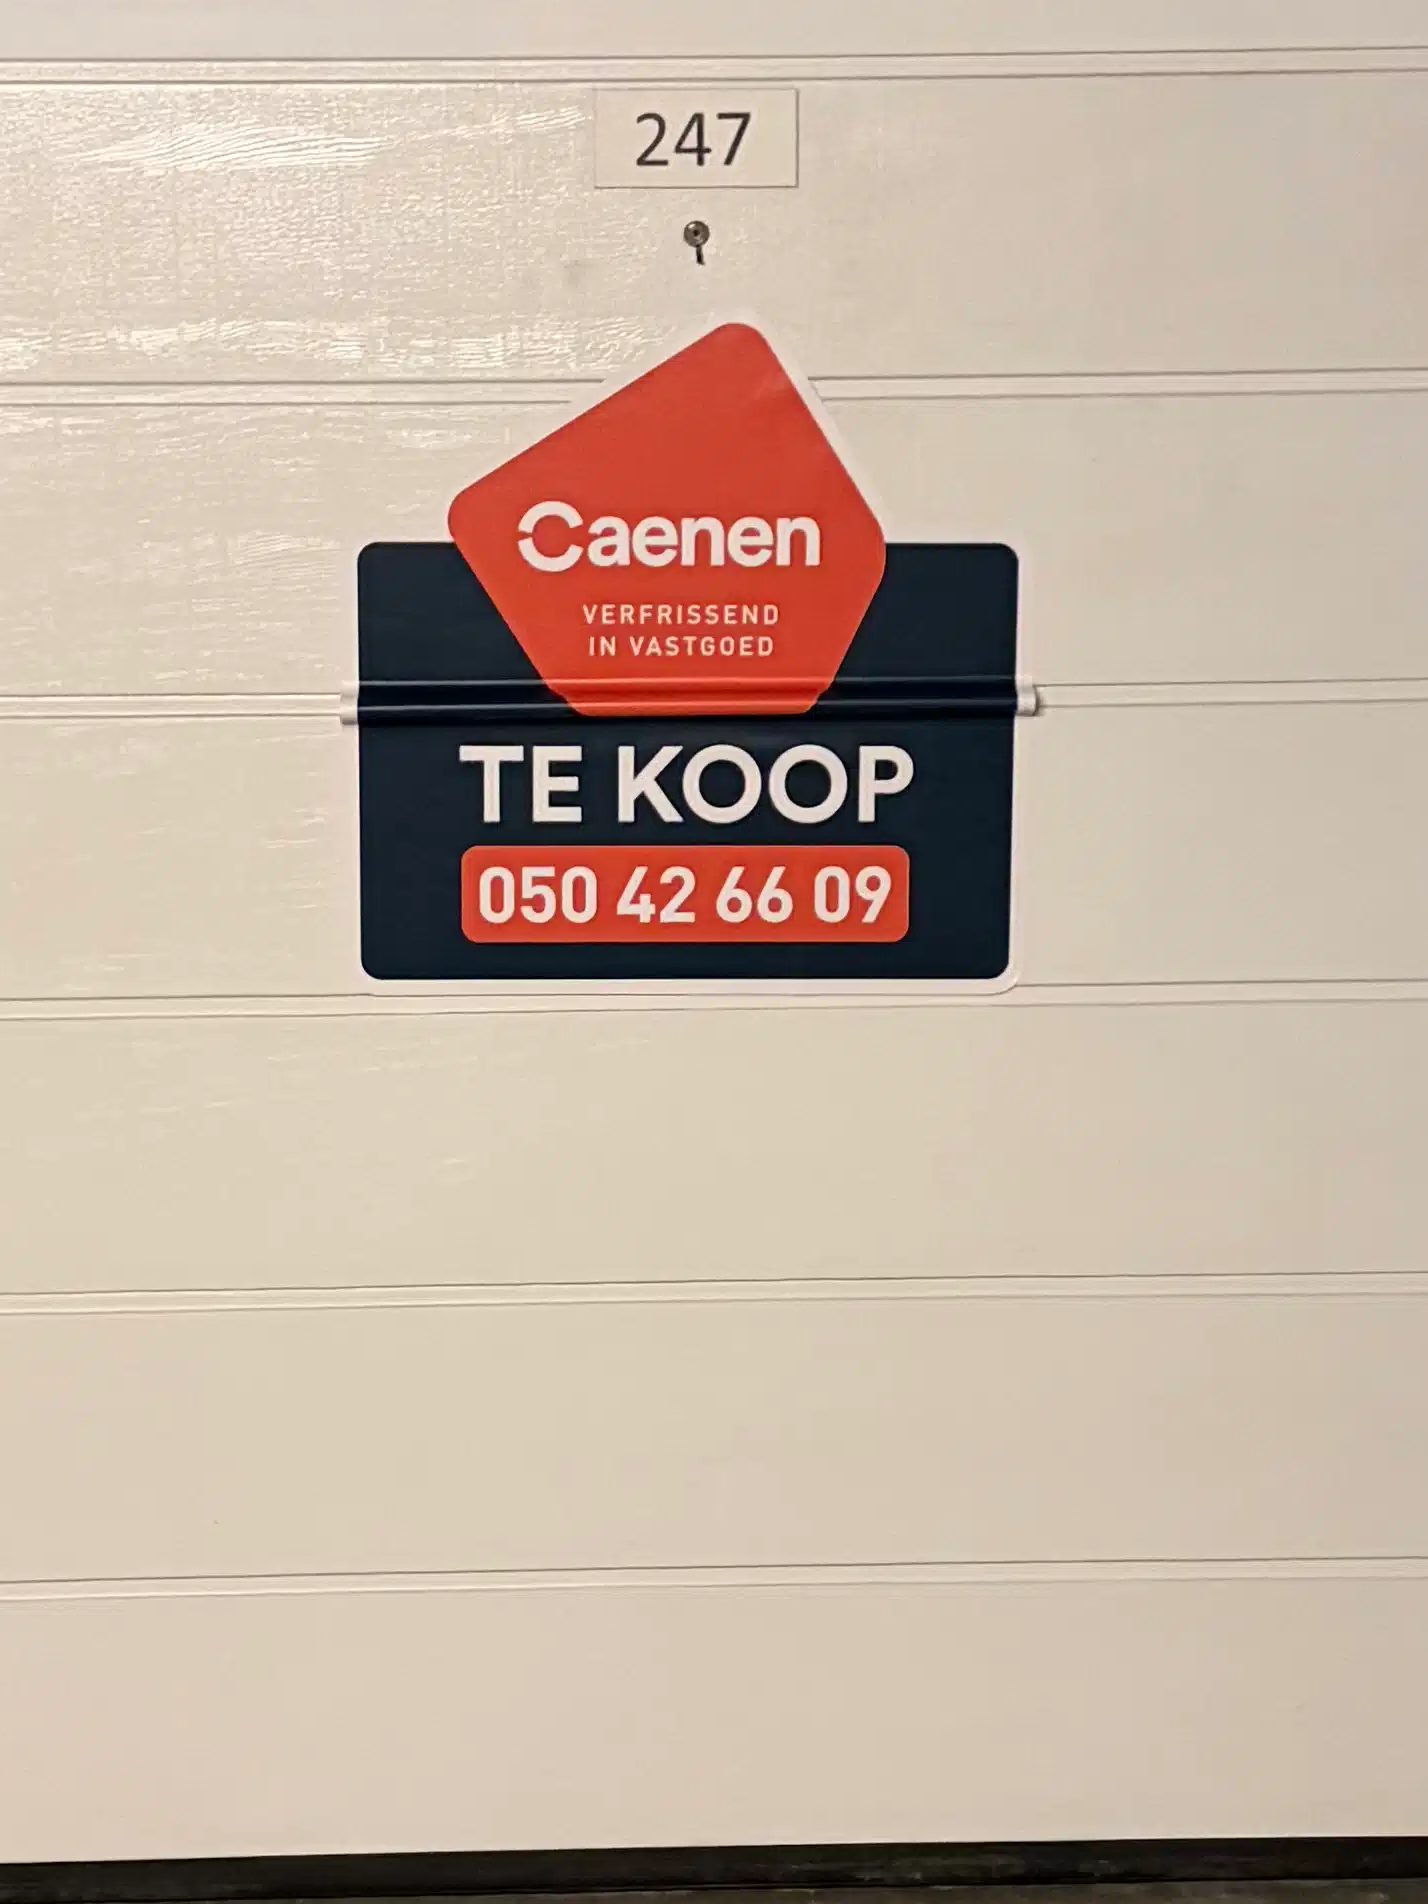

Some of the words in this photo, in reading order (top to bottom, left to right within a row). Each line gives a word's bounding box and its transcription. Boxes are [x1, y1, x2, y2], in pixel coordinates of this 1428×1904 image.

[636, 112, 751, 167] 247
[517, 500, 820, 572] Caenen
[583, 604, 778, 626] VERFRISSEND
[588, 635, 617, 657] IN
[629, 635, 774, 657] VASTGOED
[458, 745, 583, 823] TE
[617, 744, 914, 824] KOOP
[479, 866, 597, 924] 050
[616, 866, 696, 923] 42
[716, 866, 793, 923] 66
[814, 865, 892, 923] 09
